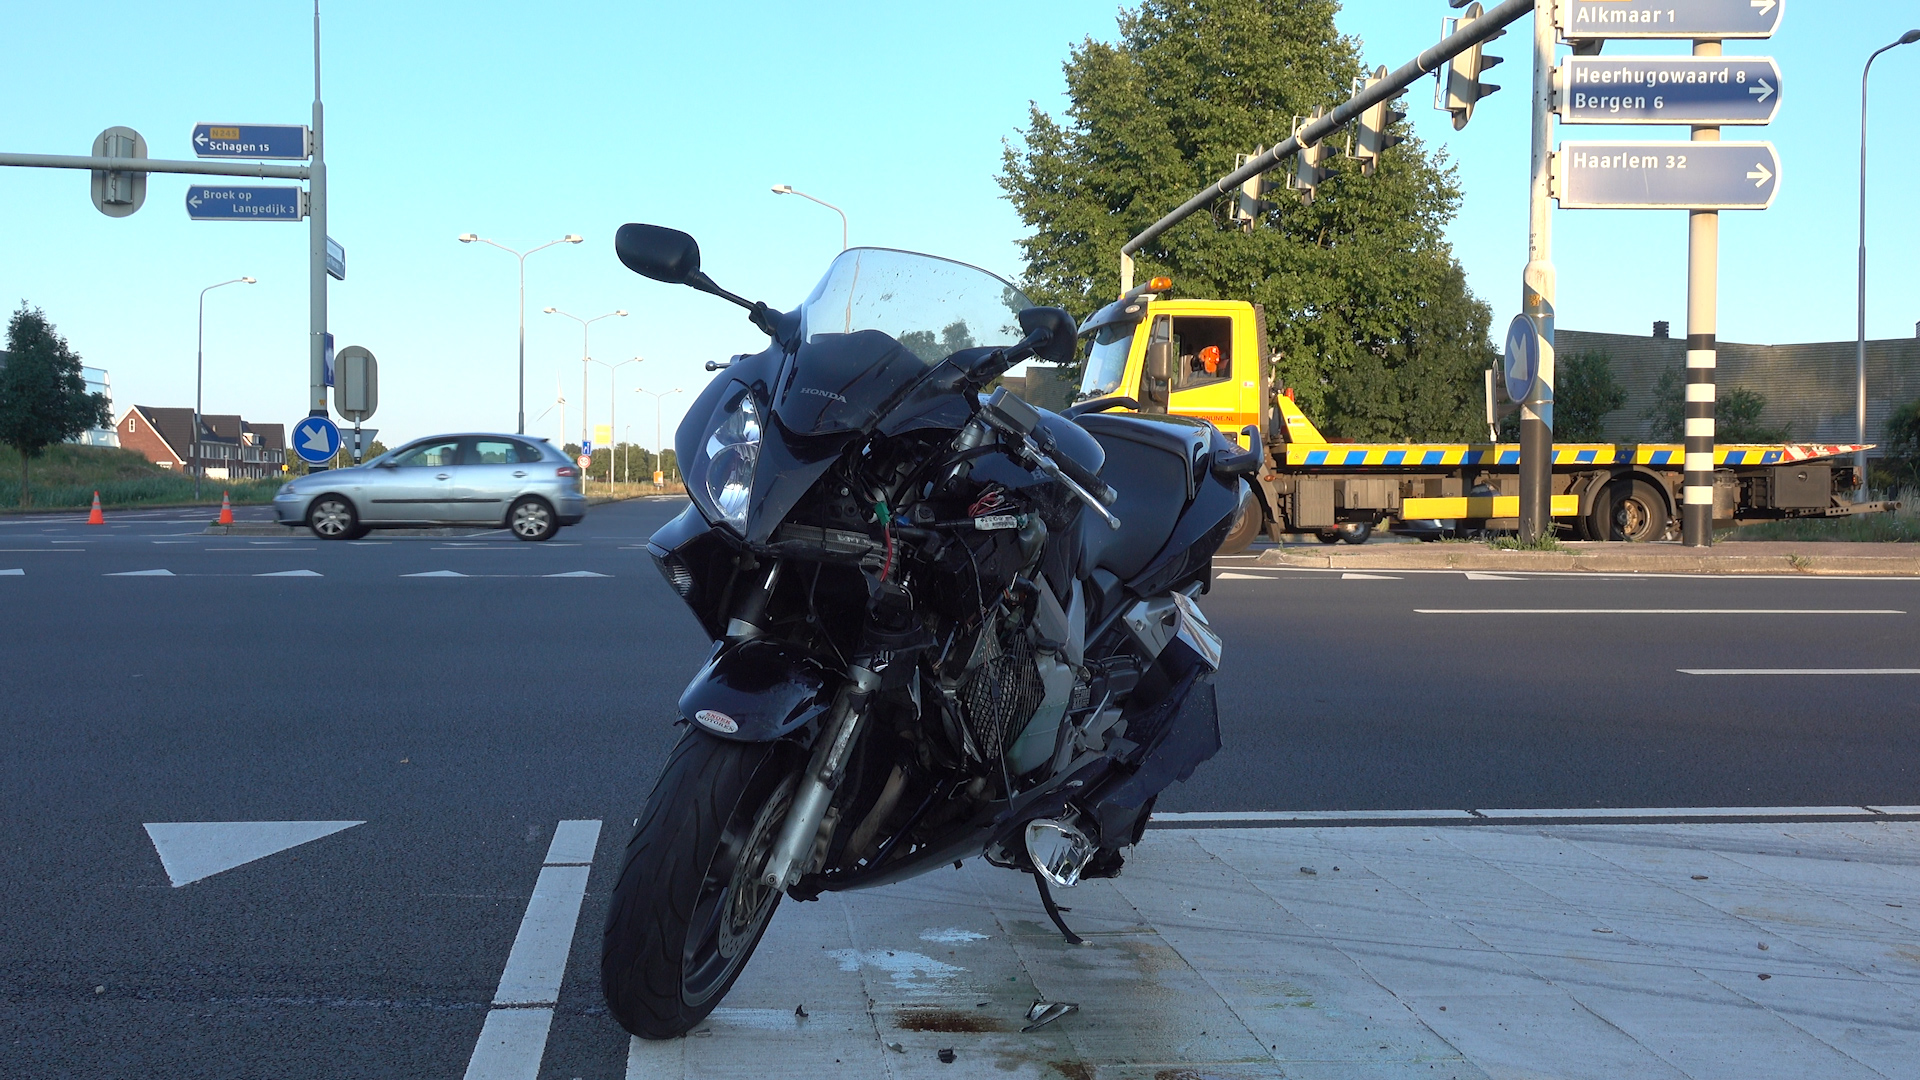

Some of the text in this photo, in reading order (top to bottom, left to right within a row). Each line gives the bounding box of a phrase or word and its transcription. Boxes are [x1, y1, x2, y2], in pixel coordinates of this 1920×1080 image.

[1576, 6, 1675, 23] Alkmaar 1
[1575, 66, 1746, 88] Heerhugowaard 8
[1575, 92, 1664, 113] Bergen 6
[212, 129, 237, 137] N245
[209, 141, 270, 153] Schagen 15
[1573, 151, 1688, 169] Haarlem 32
[203, 189, 252, 202] Broek op
[232, 203, 295, 216] Langedijk 3
[800, 387, 848, 404] HONDA
[697, 714, 735, 732] MOTOREN
